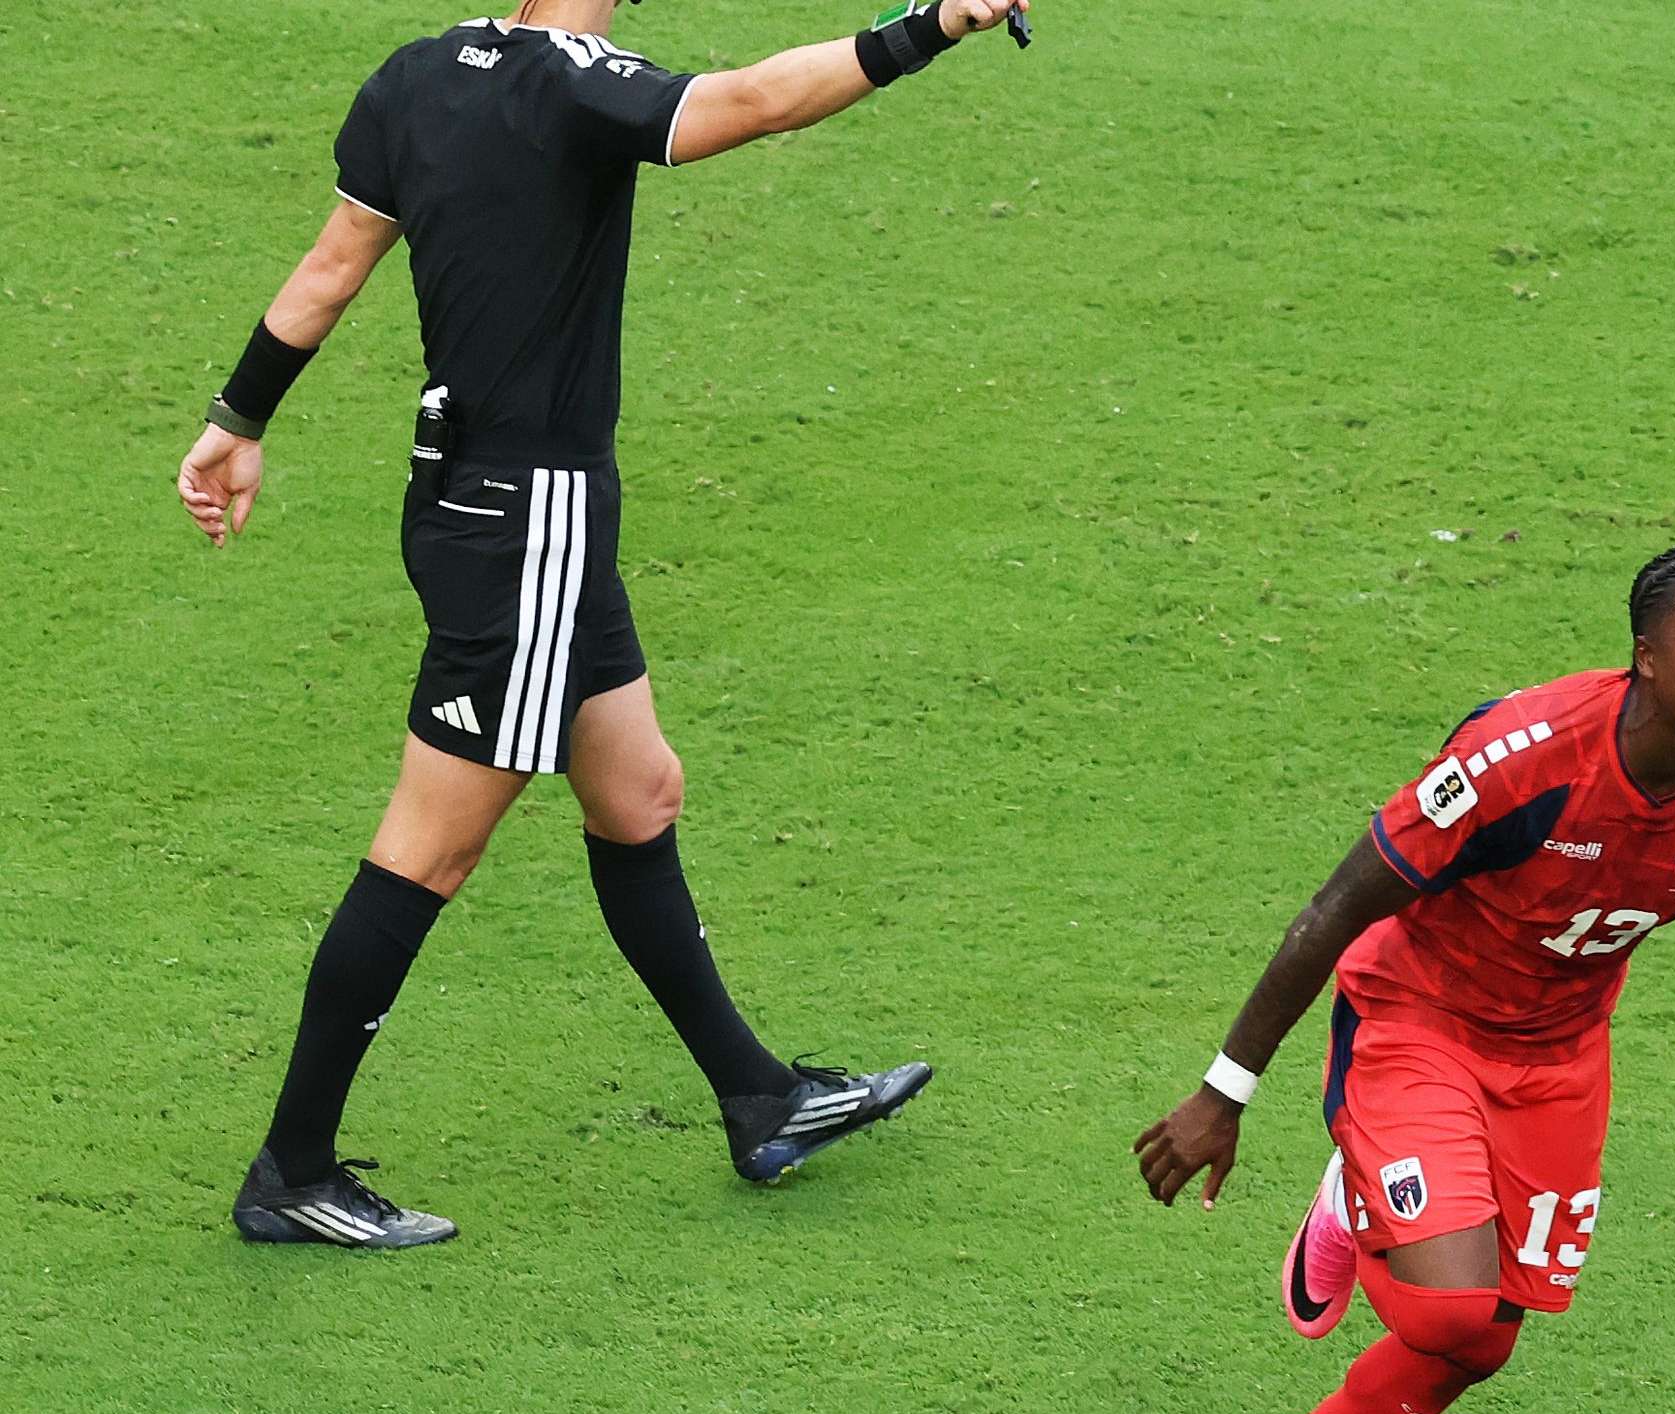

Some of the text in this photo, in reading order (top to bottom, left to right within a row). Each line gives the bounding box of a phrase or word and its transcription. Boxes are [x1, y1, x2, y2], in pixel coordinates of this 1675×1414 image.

[1543, 839, 1603, 858] capelli
[1540, 908, 1661, 958] 13
[1517, 1186, 1601, 1269] 13
